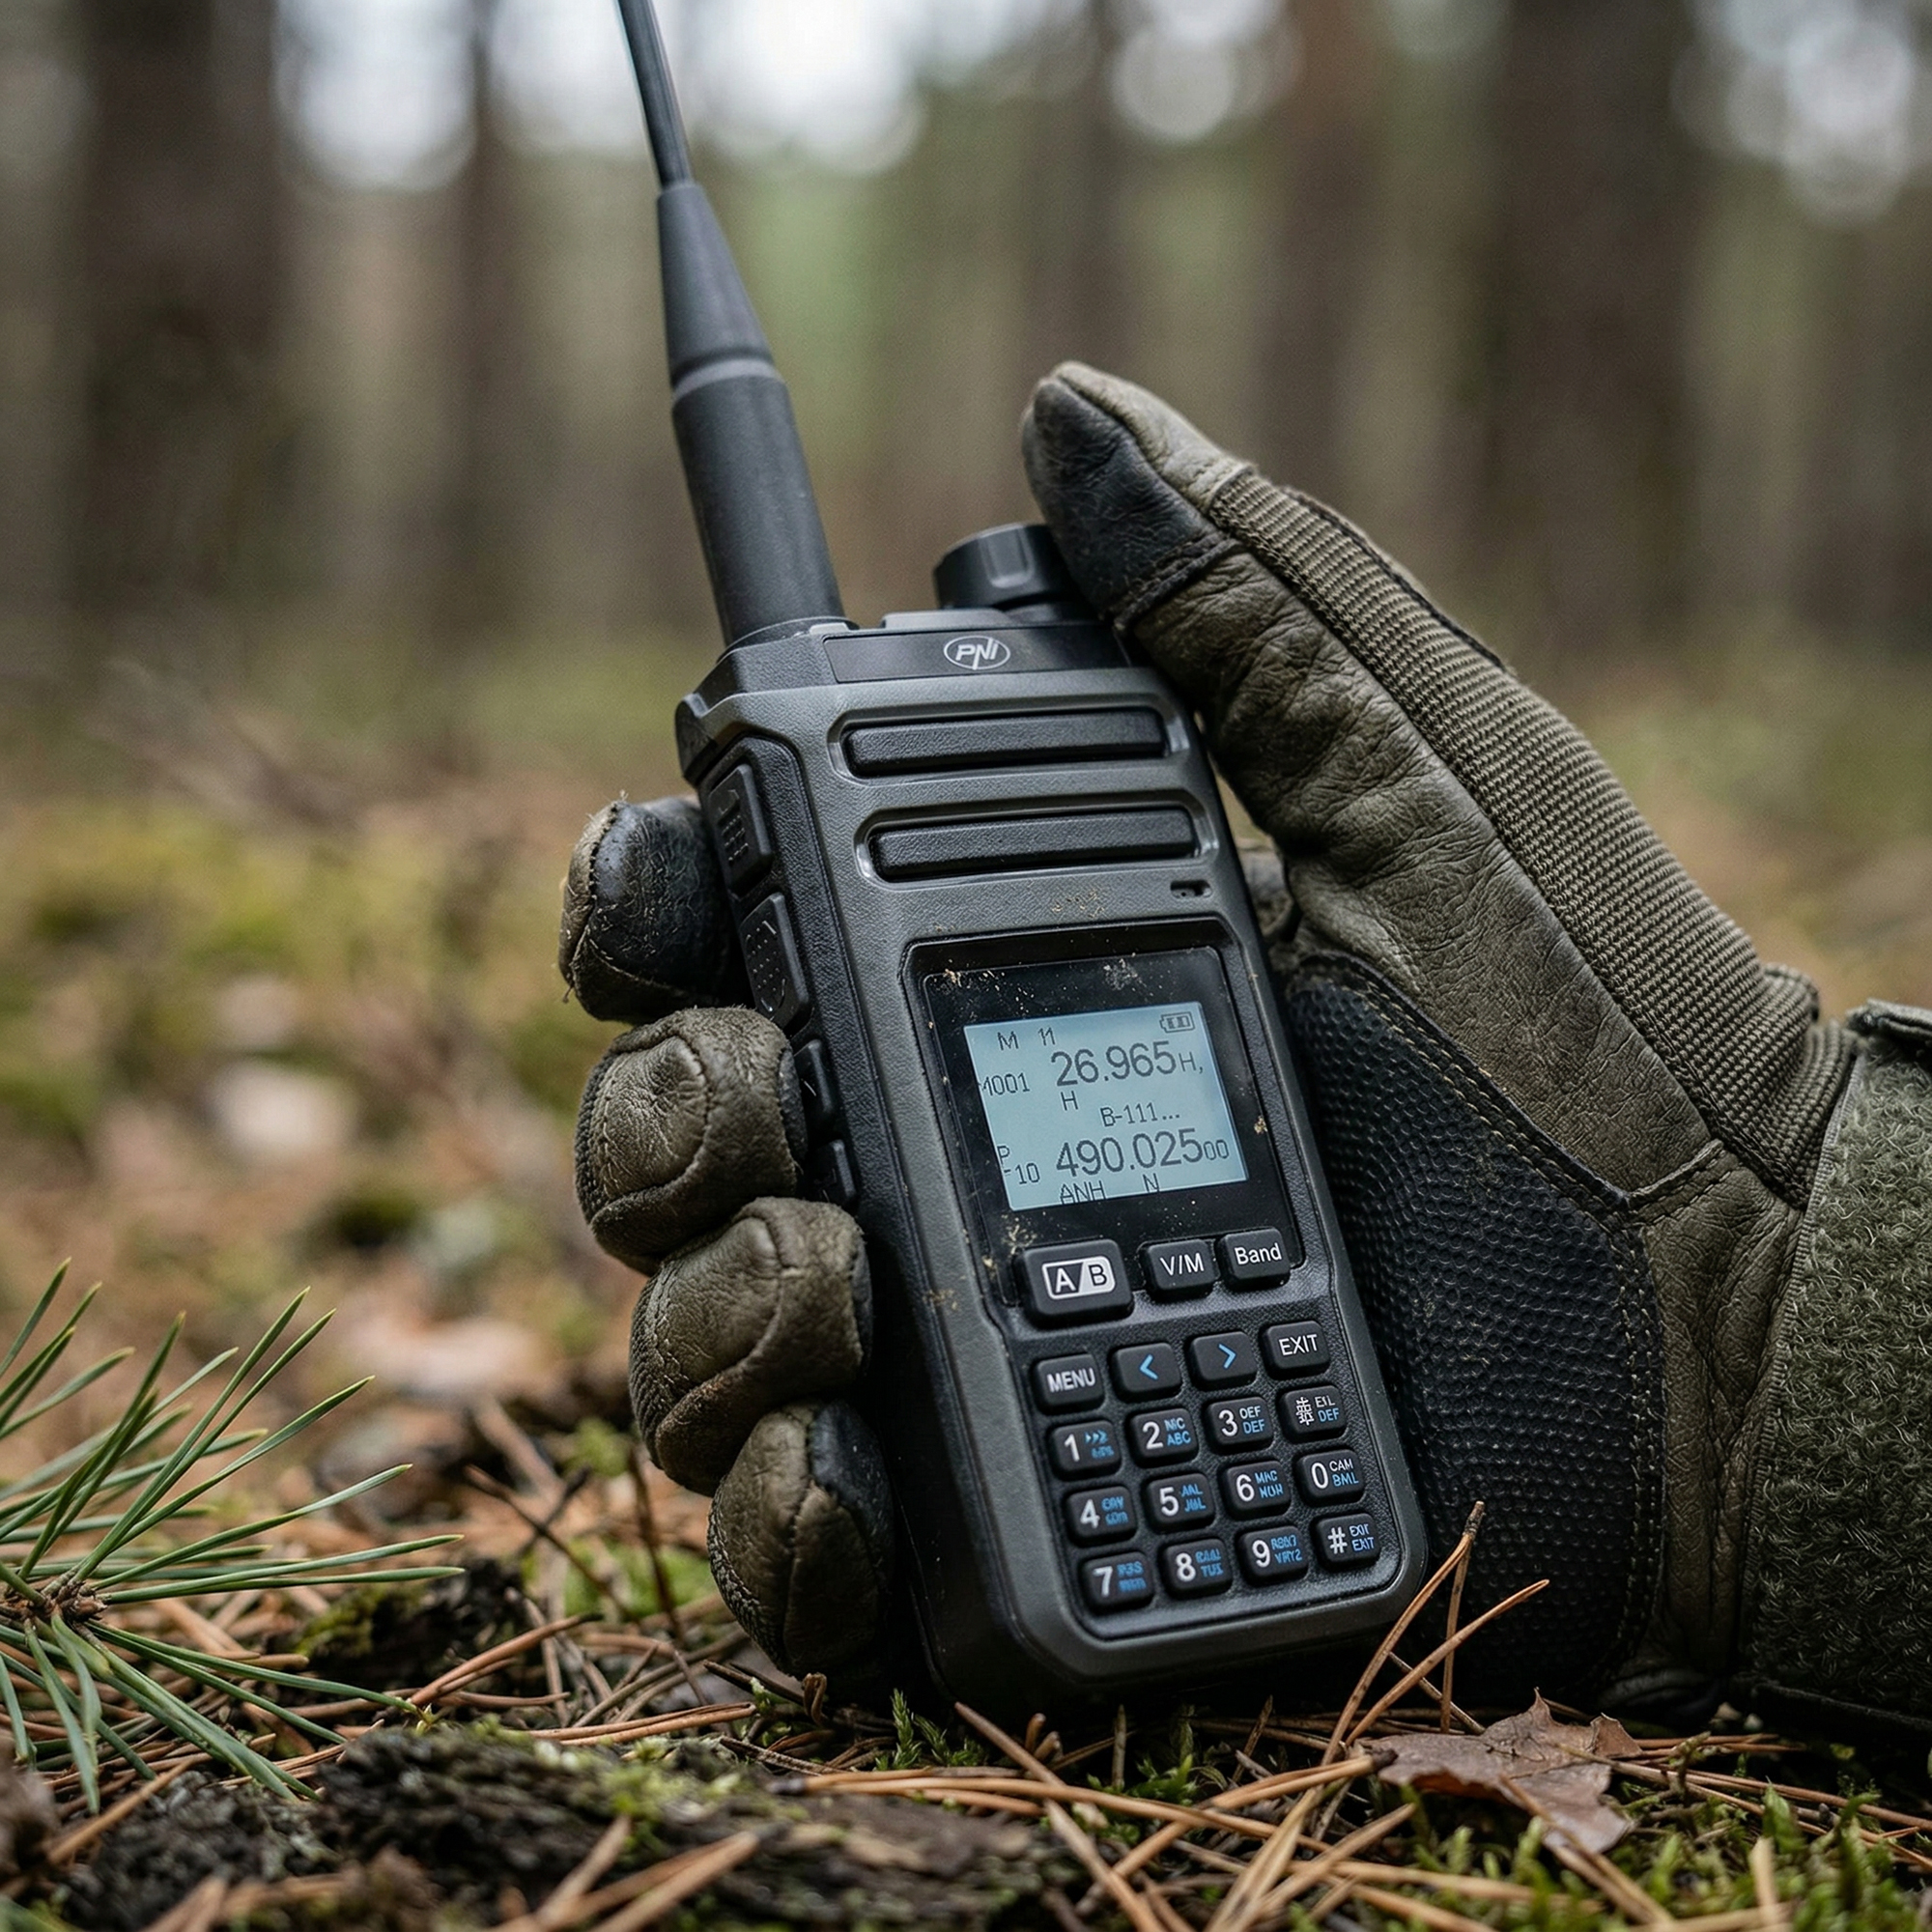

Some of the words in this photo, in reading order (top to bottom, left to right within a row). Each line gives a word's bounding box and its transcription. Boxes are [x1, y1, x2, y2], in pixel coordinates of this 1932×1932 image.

[955, 637, 999, 670] PNI
[997, 1032, 1019, 1050] M
[1061, 1091, 1079, 1111] H
[1143, 1173, 1160, 1193] N
[1160, 1253, 1205, 1276] V/M
[1234, 1242, 1283, 1266] Band
[1278, 1334, 1318, 1356] EXIT
[1047, 1368, 1095, 1392] MENU
[1218, 1409, 1238, 1436] 3
[1242, 1419, 1265, 1435] DEF
[1318, 1407, 1340, 1423] DEF
[1064, 1434, 1080, 1462] 1
[1142, 1422, 1164, 1449] 2
[1167, 1431, 1191, 1446] ABC
[1311, 1462, 1329, 1490] 0
[1328, 1458, 1354, 1472] CAM
[1236, 1474, 1255, 1502] 6
[1080, 1498, 1100, 1529] 4
[1159, 1487, 1179, 1517] 5
[1251, 1539, 1271, 1568] 9
[1327, 1526, 1349, 1555] #
[1176, 1552, 1197, 1581] 8
[1093, 1565, 1113, 1597] 7
